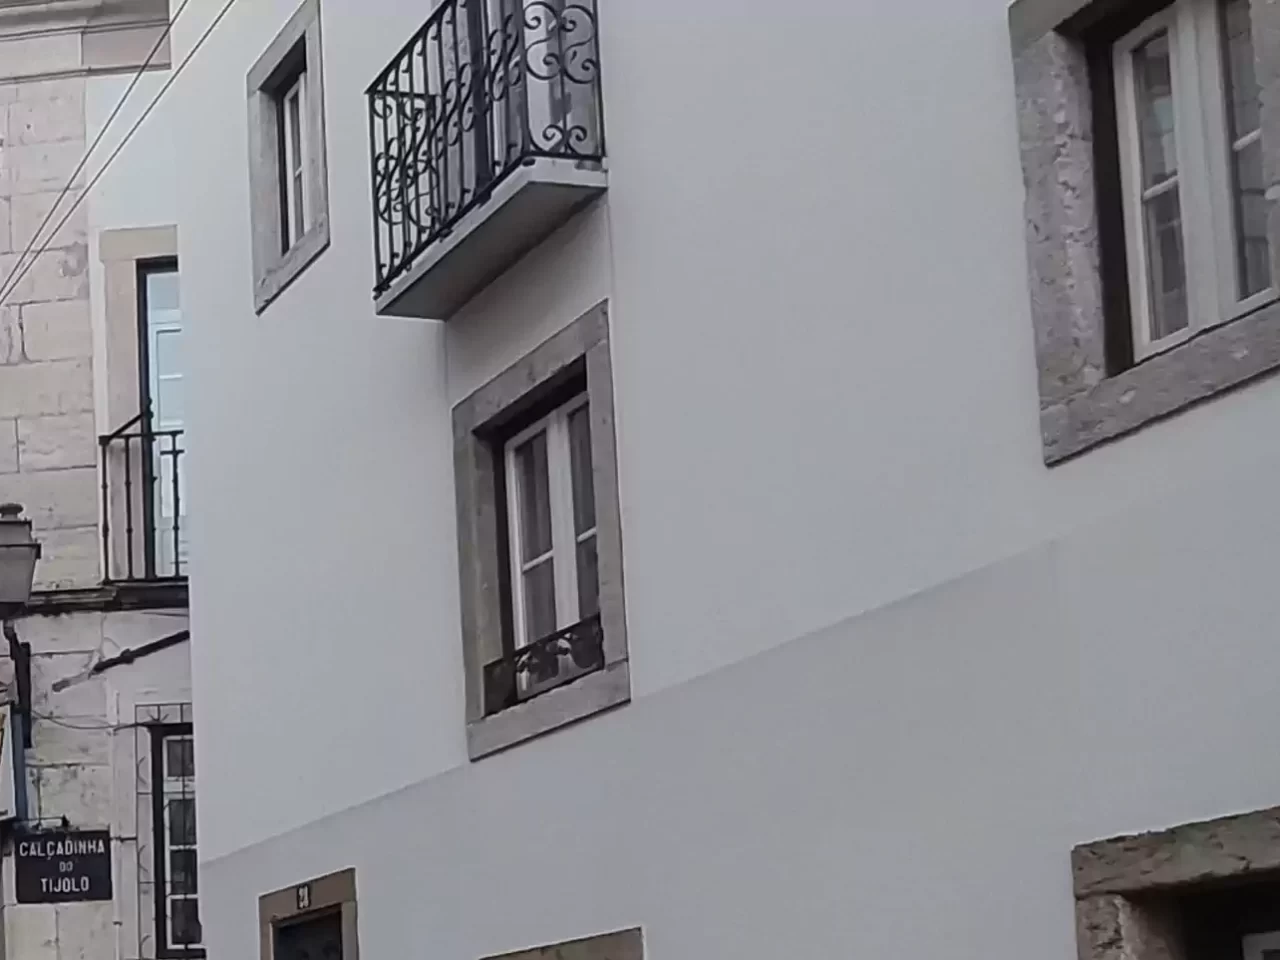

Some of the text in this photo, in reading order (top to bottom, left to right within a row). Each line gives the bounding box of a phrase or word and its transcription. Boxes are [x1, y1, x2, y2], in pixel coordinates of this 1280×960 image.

[19, 838, 105, 860] CALÇADINHA
[59, 861, 74, 873] DO
[40, 876, 90, 893] TIJOLO
